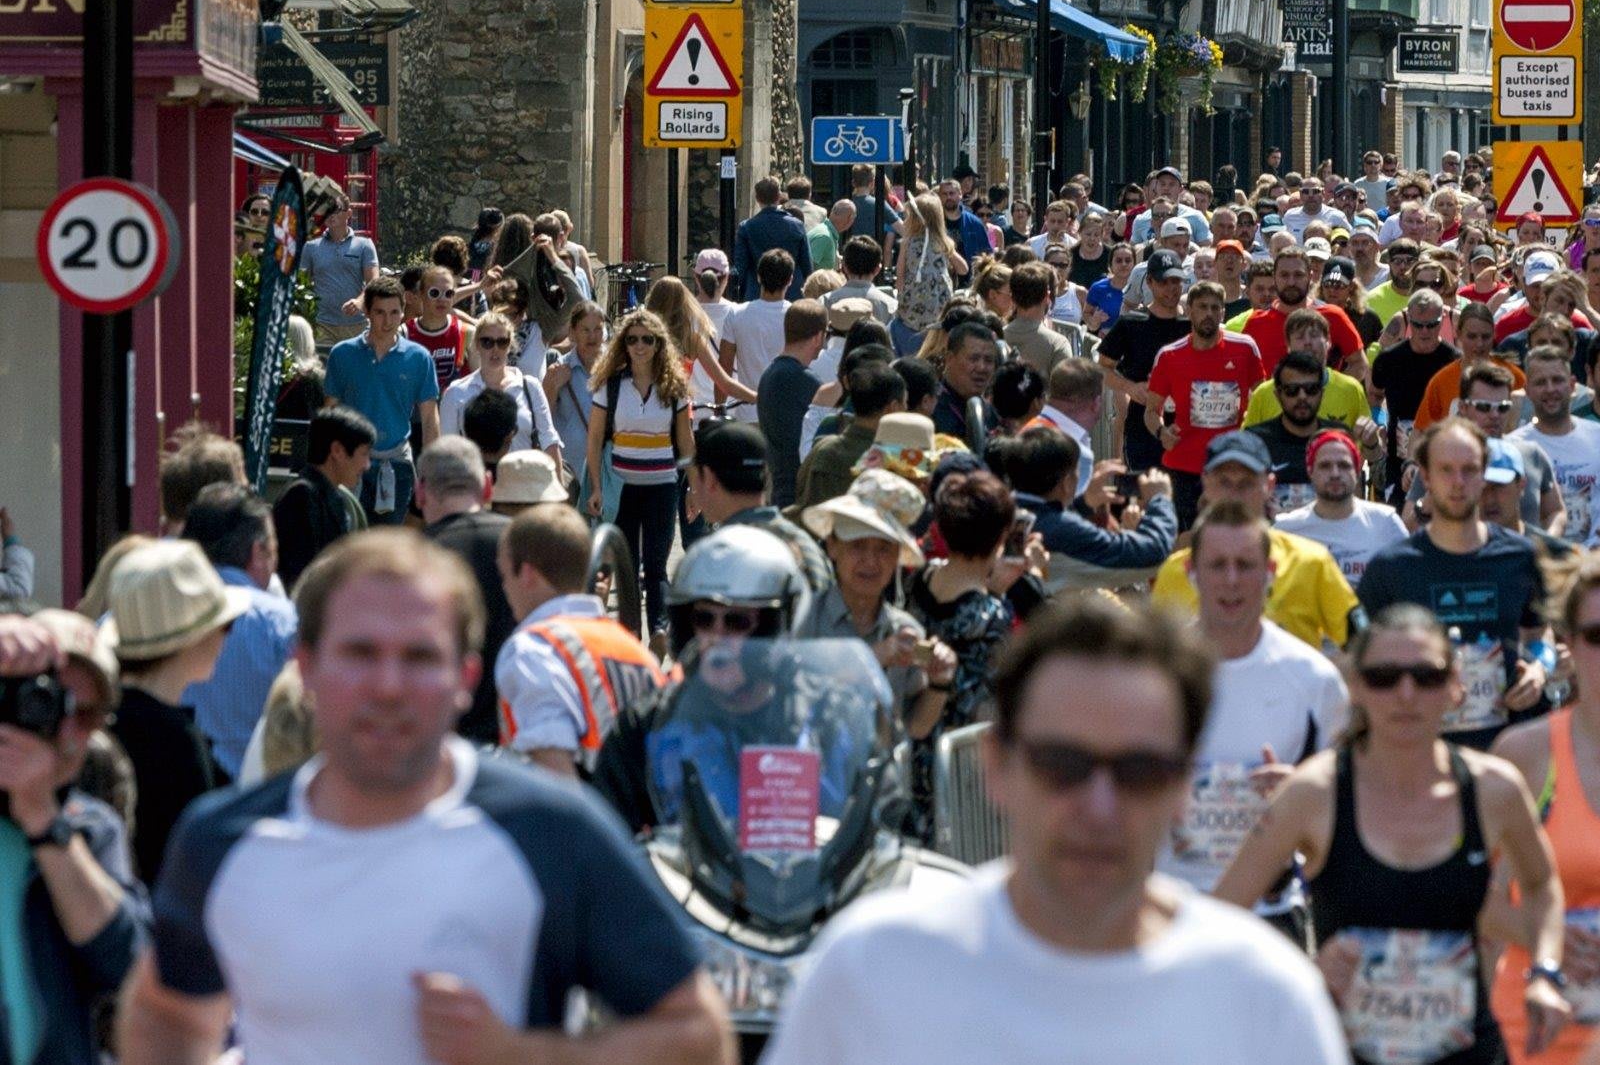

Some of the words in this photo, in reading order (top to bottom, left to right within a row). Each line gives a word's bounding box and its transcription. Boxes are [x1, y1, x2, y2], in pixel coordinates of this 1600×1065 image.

[1285, 13, 1312, 21] VISUAL
[1284, 27, 1326, 41] ARTS
[1405, 40, 1451, 52] BYRON
[358, 56, 383, 65] Menu
[1517, 62, 1559, 74] Except
[1505, 75, 1570, 85] authorised
[1507, 88, 1542, 98] buses
[1546, 88, 1568, 98] and
[1523, 100, 1552, 111] taxis
[673, 108, 713, 122] Rising
[665, 121, 721, 135] Bollards
[61, 218, 150, 270] 20
